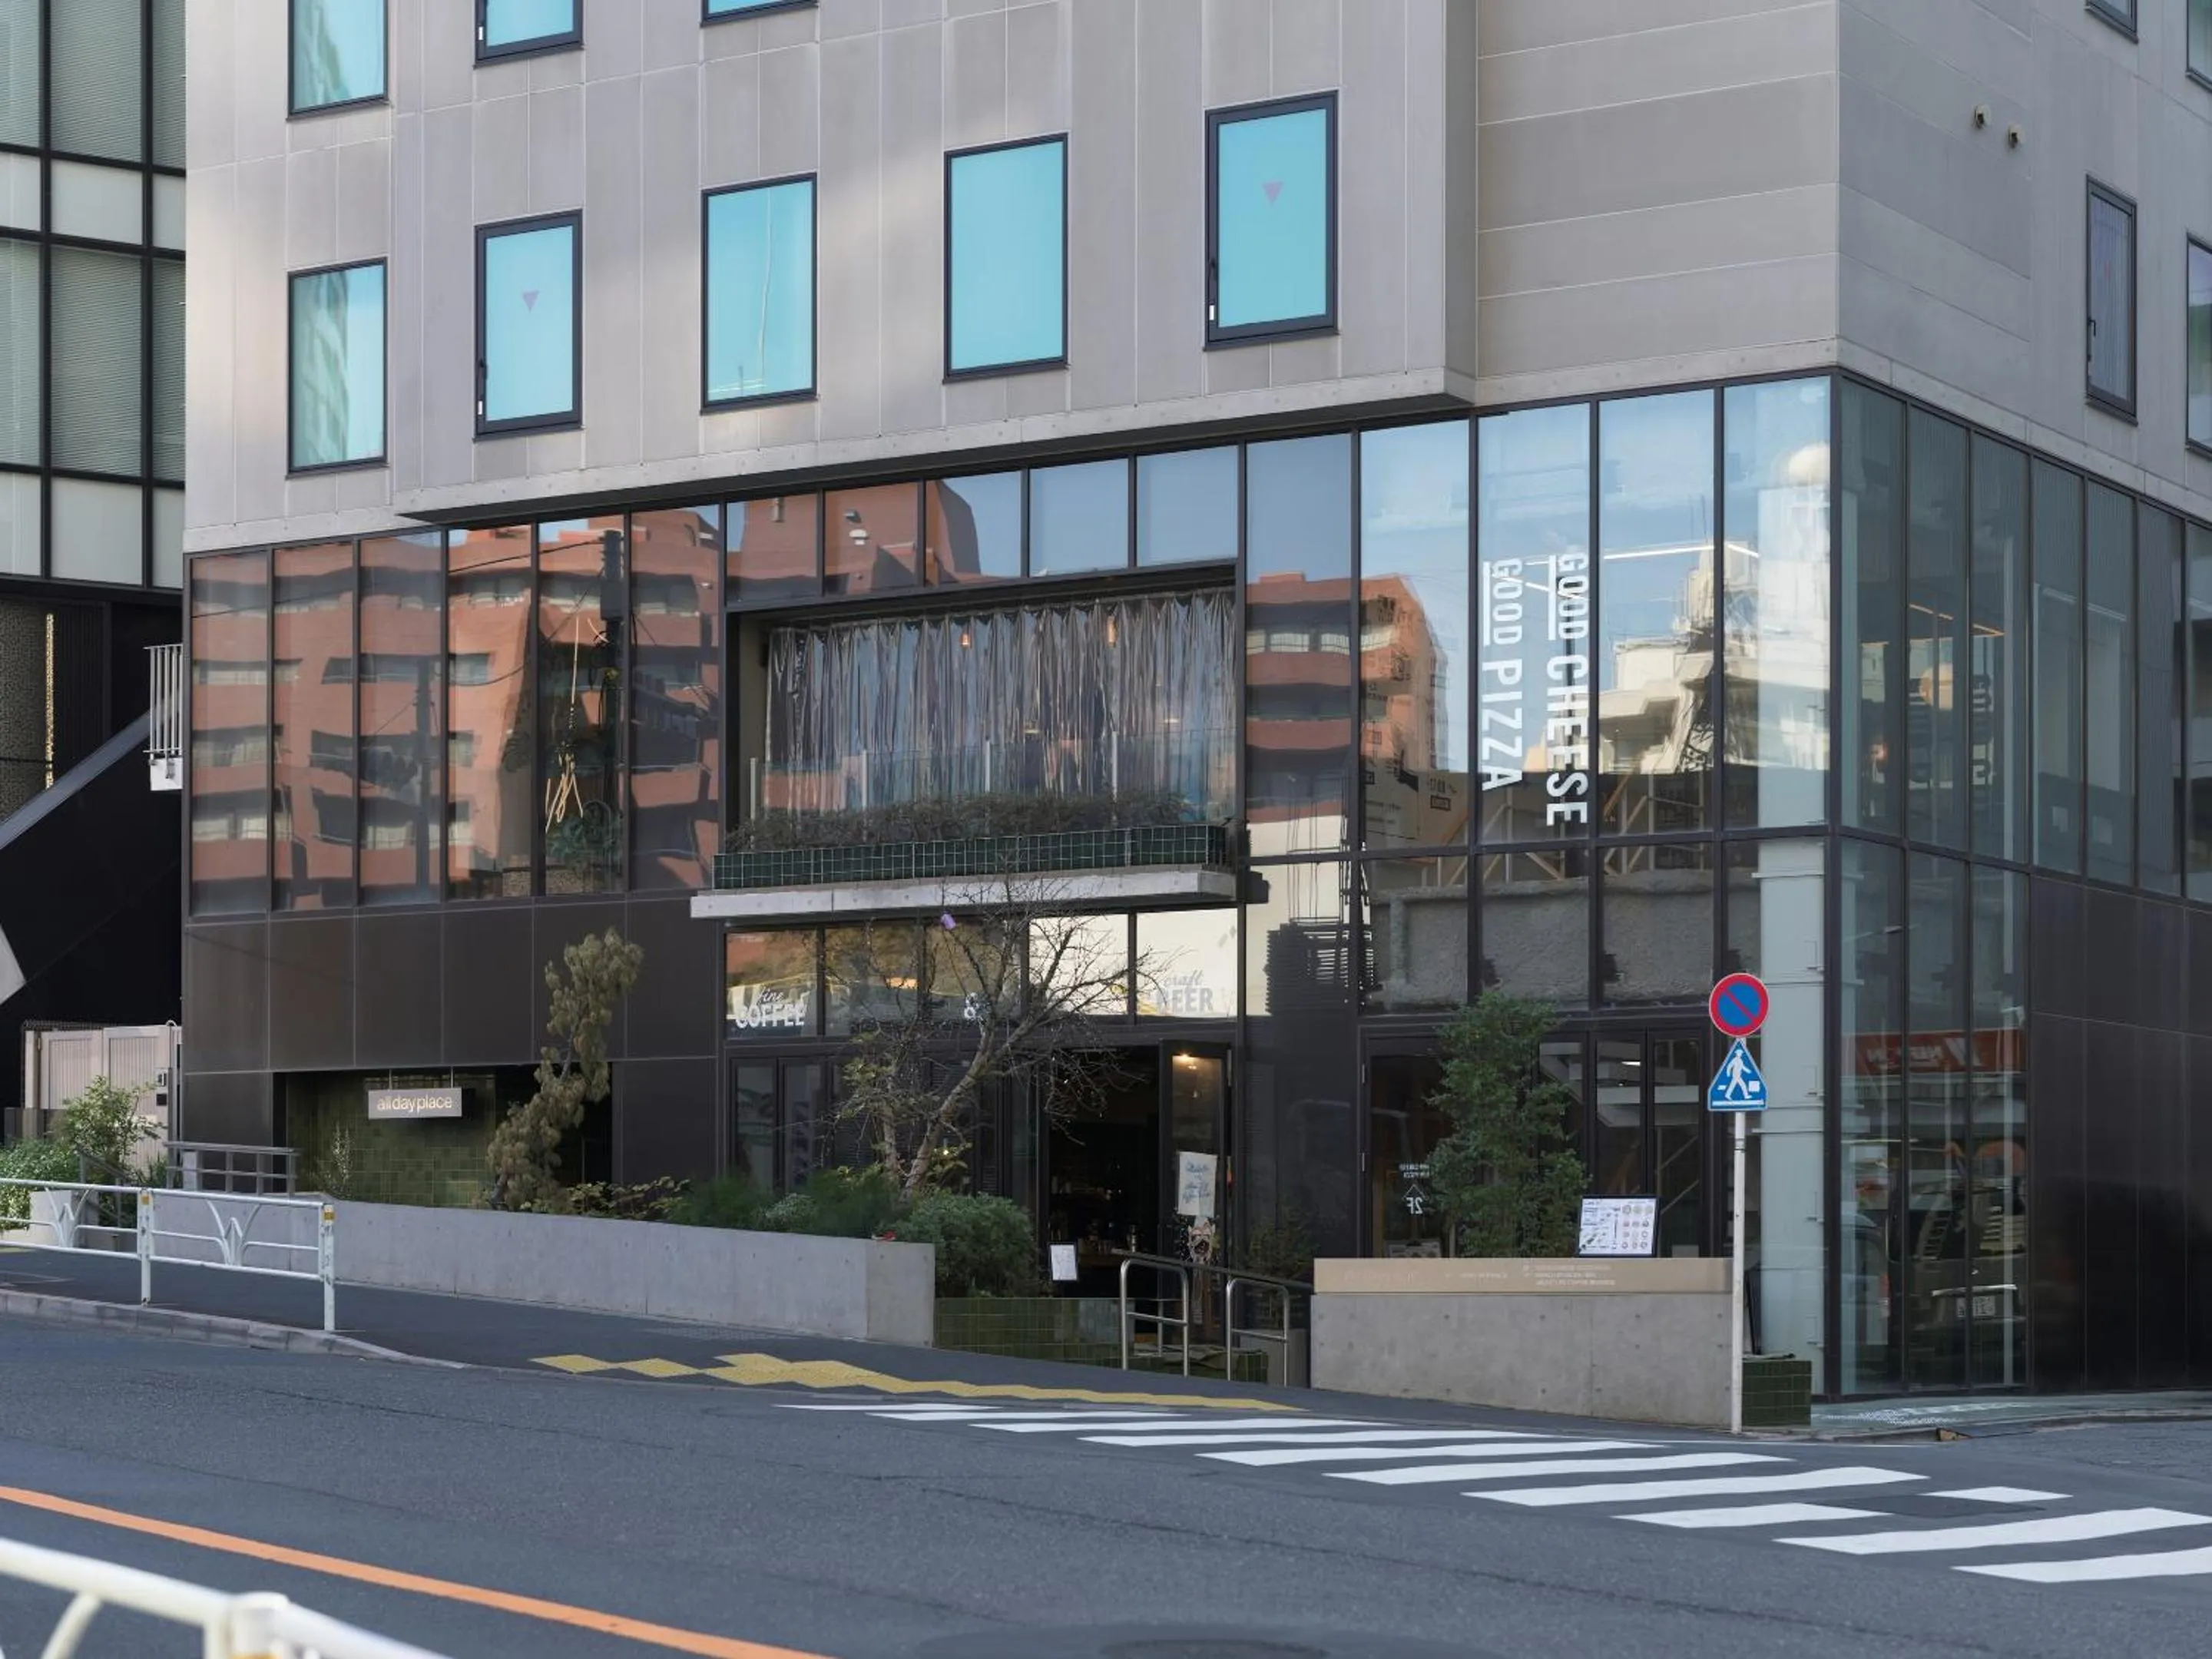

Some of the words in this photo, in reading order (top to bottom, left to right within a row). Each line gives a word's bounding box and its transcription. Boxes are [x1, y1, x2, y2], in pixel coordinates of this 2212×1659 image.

[1492, 558, 1522, 645] GOOD
[1558, 552, 1589, 639] GOOD
[1482, 659, 1522, 791] PIZZA
[1546, 654, 1588, 826] CHEESE
